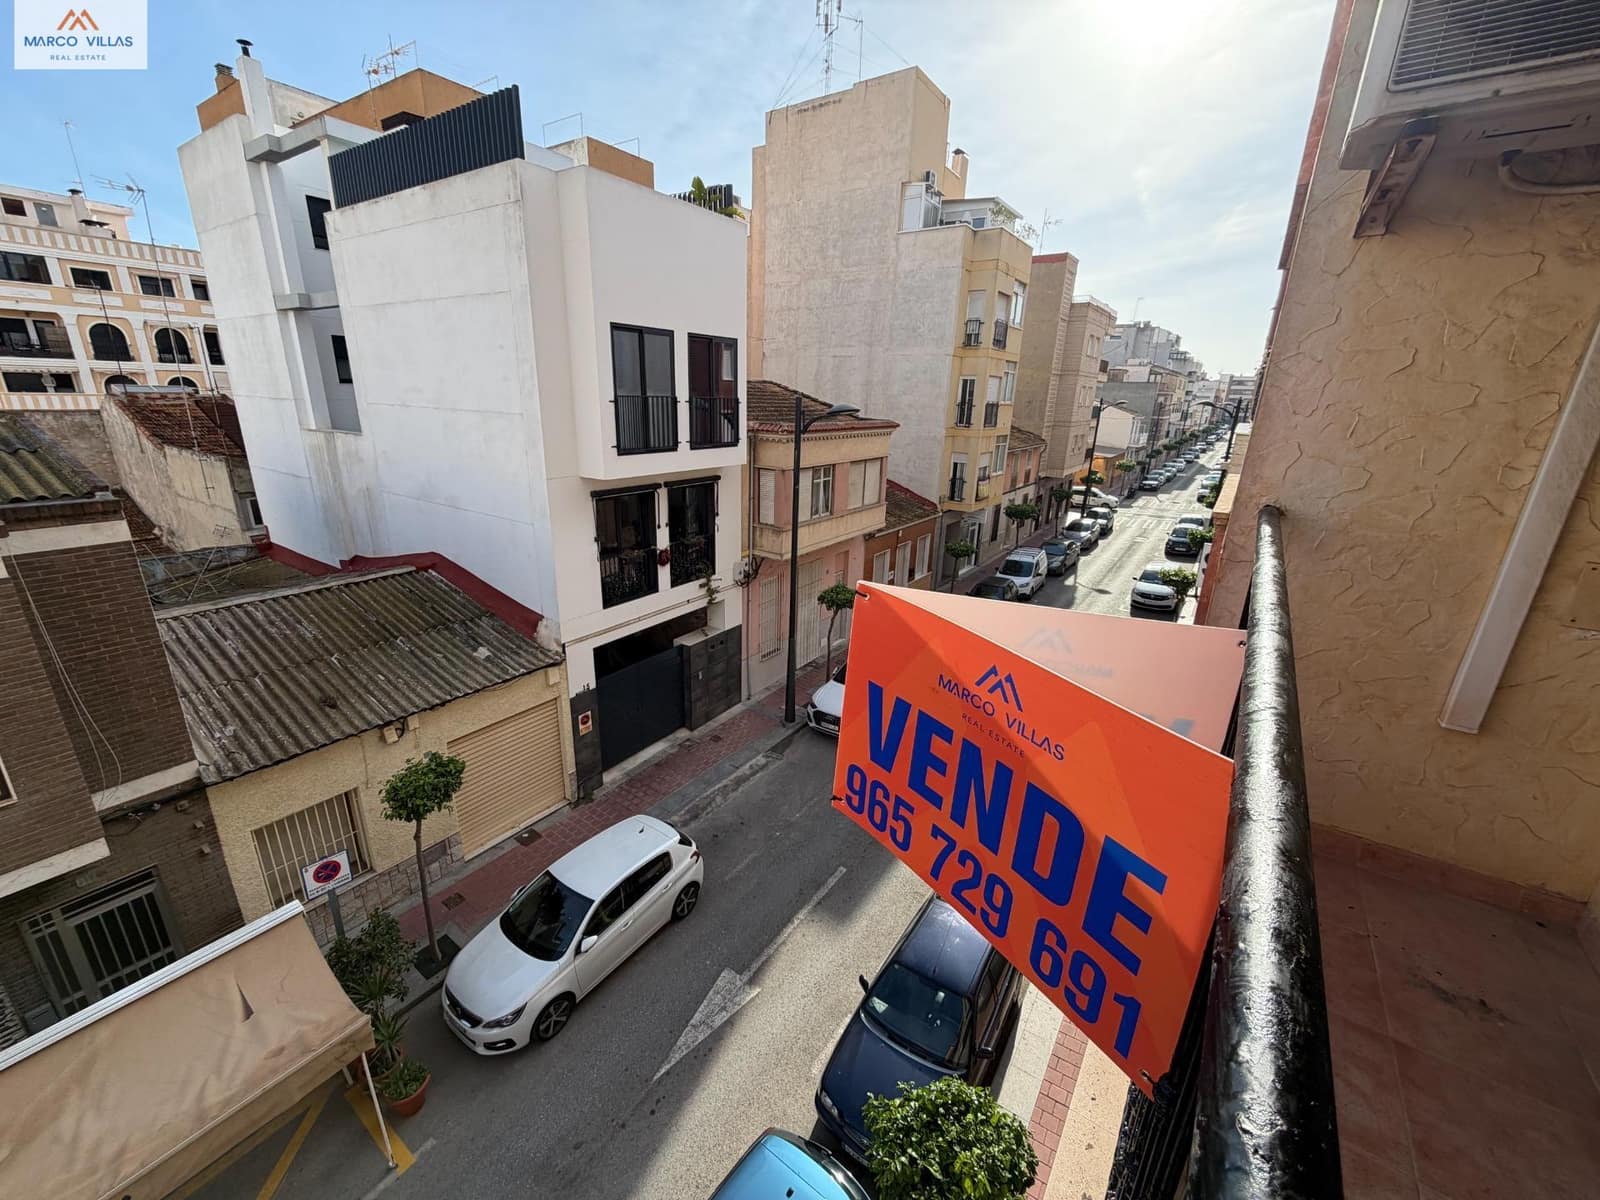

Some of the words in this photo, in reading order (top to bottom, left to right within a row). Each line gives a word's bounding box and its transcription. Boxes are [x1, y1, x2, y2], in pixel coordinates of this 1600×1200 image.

[938, 673, 996, 717] MARCO
[1006, 712, 1065, 761] VILLAS
[961, 712, 985, 733] REAL
[988, 732, 1025, 759] ESTATE
[845, 763, 913, 853] 965
[929, 823, 1015, 938] 729
[1029, 918, 1143, 1060] 691
[867, 680, 1168, 977] VENDE
